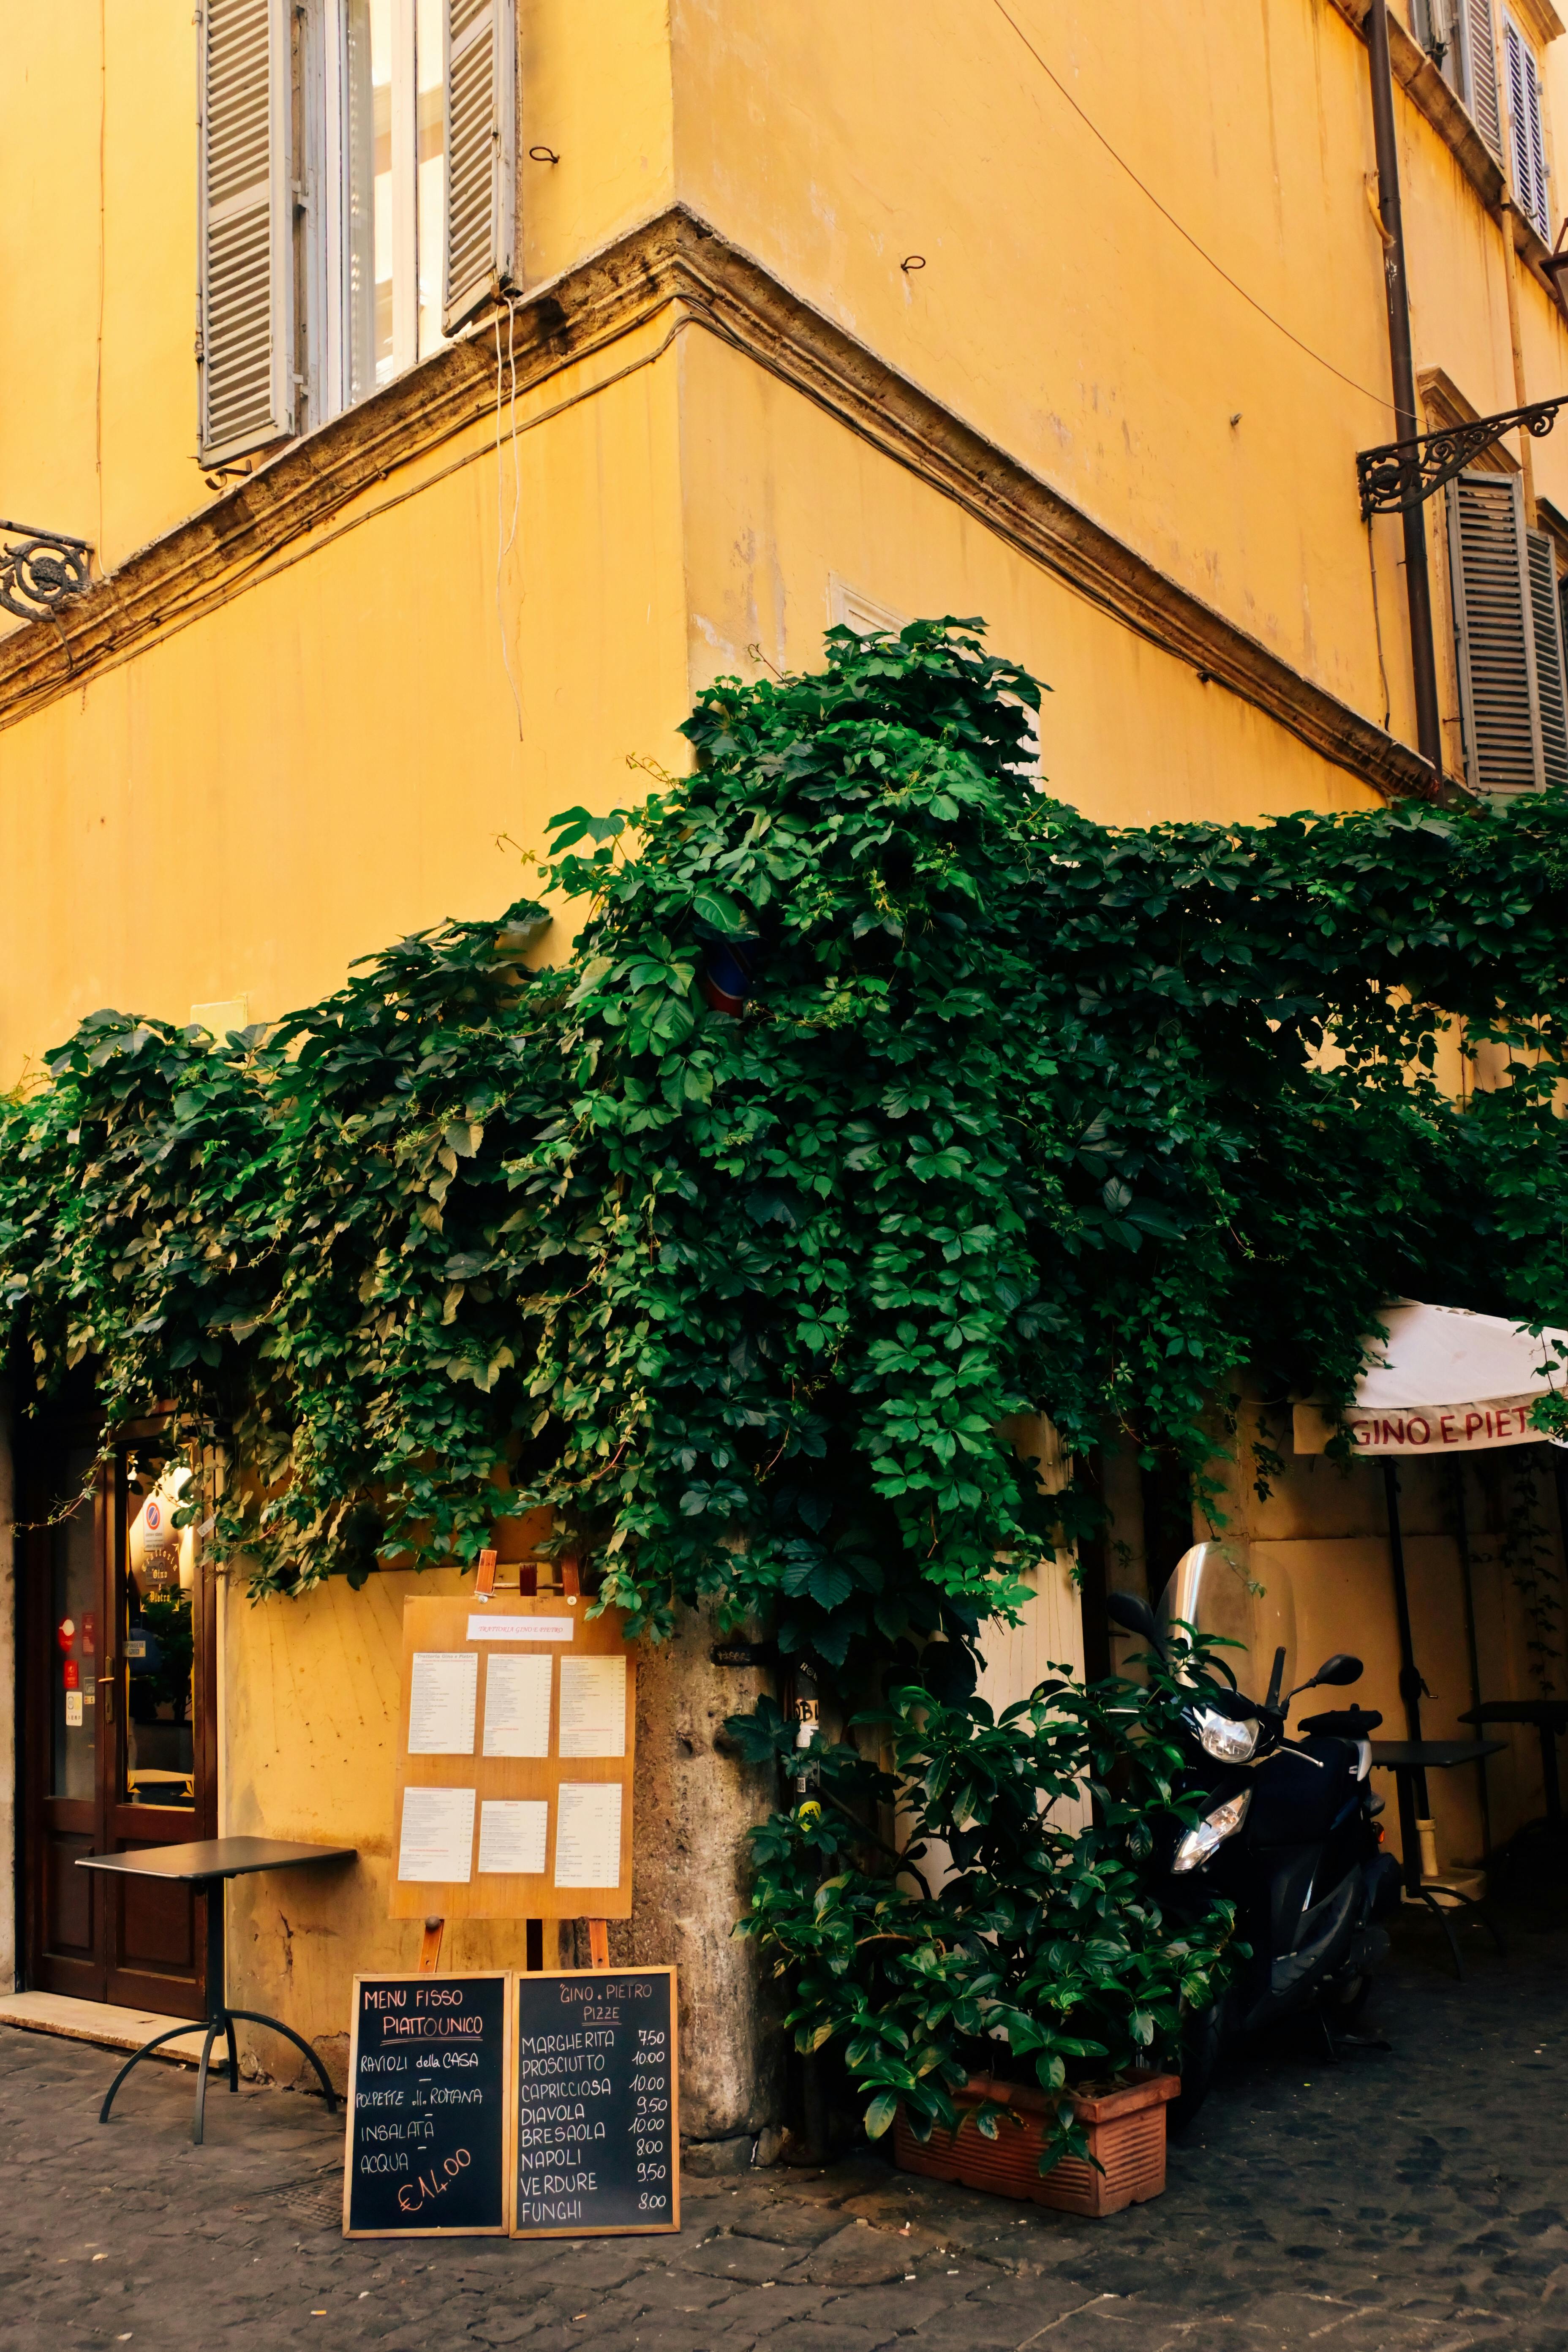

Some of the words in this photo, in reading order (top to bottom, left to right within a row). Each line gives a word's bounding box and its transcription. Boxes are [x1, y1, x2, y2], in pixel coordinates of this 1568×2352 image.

[1353, 1417, 1430, 1446] GINO
[1440, 1415, 1459, 1444] E
[1466, 1405, 1538, 1441] PIET
[365, 1990, 406, 2010] MENU
[416, 1990, 463, 2007] FISSO
[606, 1984, 652, 1999] PIETRO
[583, 2006, 620, 2021] PIZZE
[522, 2030, 615, 2054] MARGHERITA
[361, 2055, 407, 2073] RAVIOLI
[416, 2053, 441, 2068] della
[443, 2053, 478, 2068] CASA
[523, 2054, 605, 2079] PROSCIUTTO
[632, 2051, 665, 2066] 10.00
[357, 2090, 404, 2108] POLPETTE
[430, 2088, 483, 2104] ROMANA
[522, 2078, 611, 2102] CAPRICCIOSA
[629, 2074, 664, 2091] 10.00
[522, 2104, 585, 2126] DIAVOLA
[637, 2096, 668, 2115] 9.50
[362, 2121, 434, 2142] INSALATA
[522, 2122, 605, 2147] BRESAOLA
[628, 2117, 664, 2134] 10.00
[361, 2153, 408, 2173] ACQUA
[522, 2148, 581, 2171] NAPOLI
[637, 2138, 663, 2156] 8.00
[520, 2172, 598, 2197] VERDURE
[637, 2163, 666, 2182] 9.50
[523, 2200, 581, 2223] FUNGHI
[638, 2192, 666, 2210] 8.00
